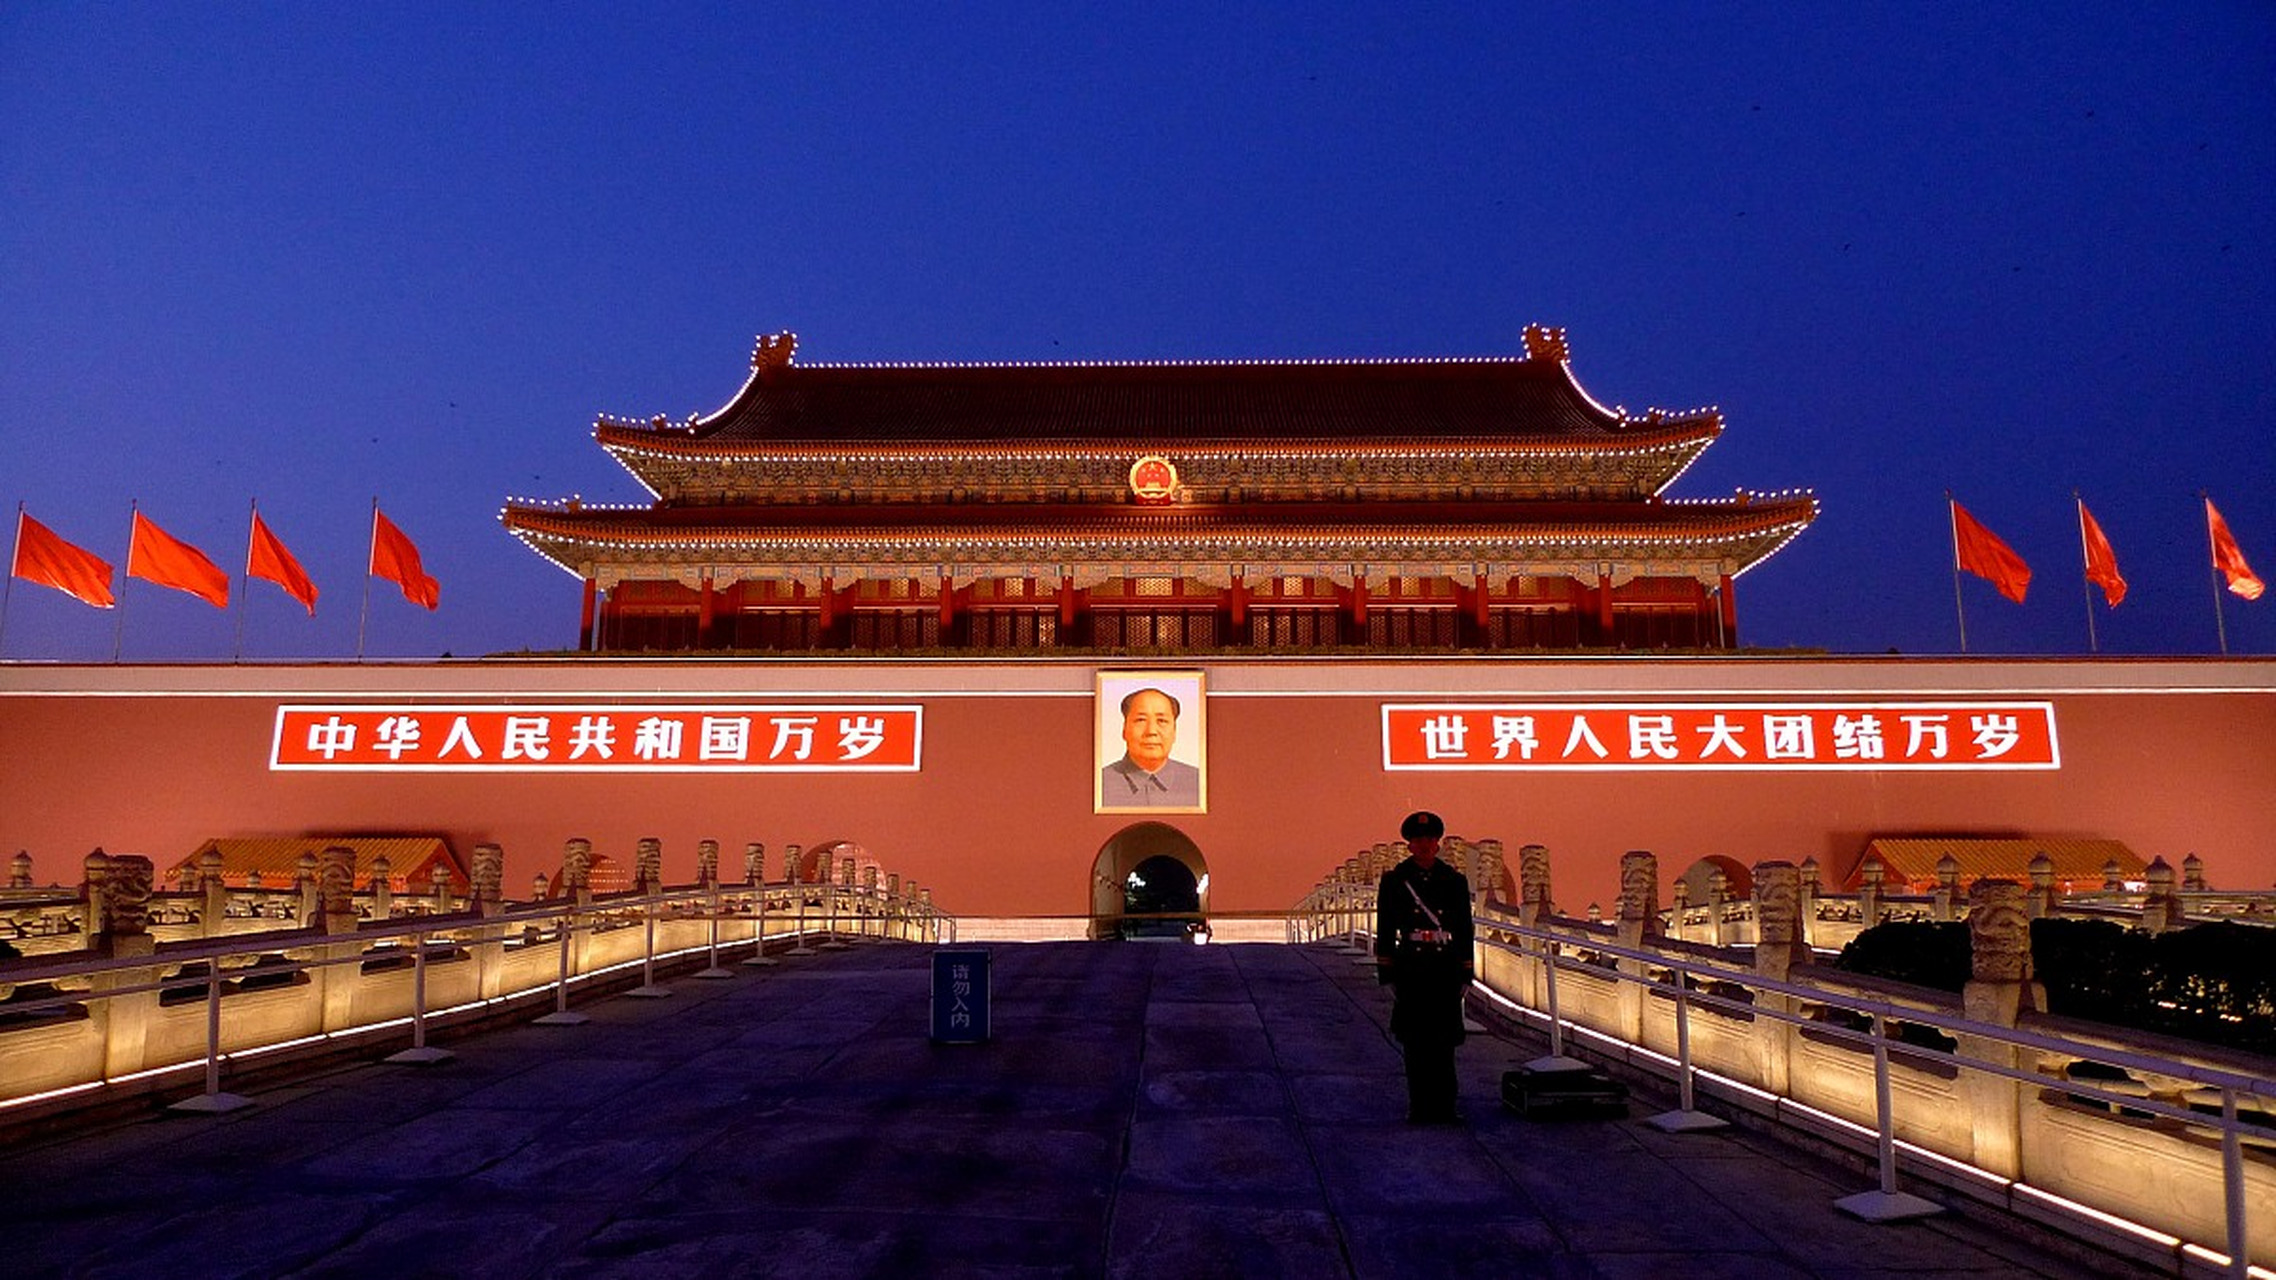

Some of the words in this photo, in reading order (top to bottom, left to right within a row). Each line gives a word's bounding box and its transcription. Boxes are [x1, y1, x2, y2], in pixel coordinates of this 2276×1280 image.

[307, 716, 884, 760] 中华人民共和国万岁
[1420, 714, 2019, 759] 世界人民大团结万岁
[951, 964, 970, 1029] 请勿入内
